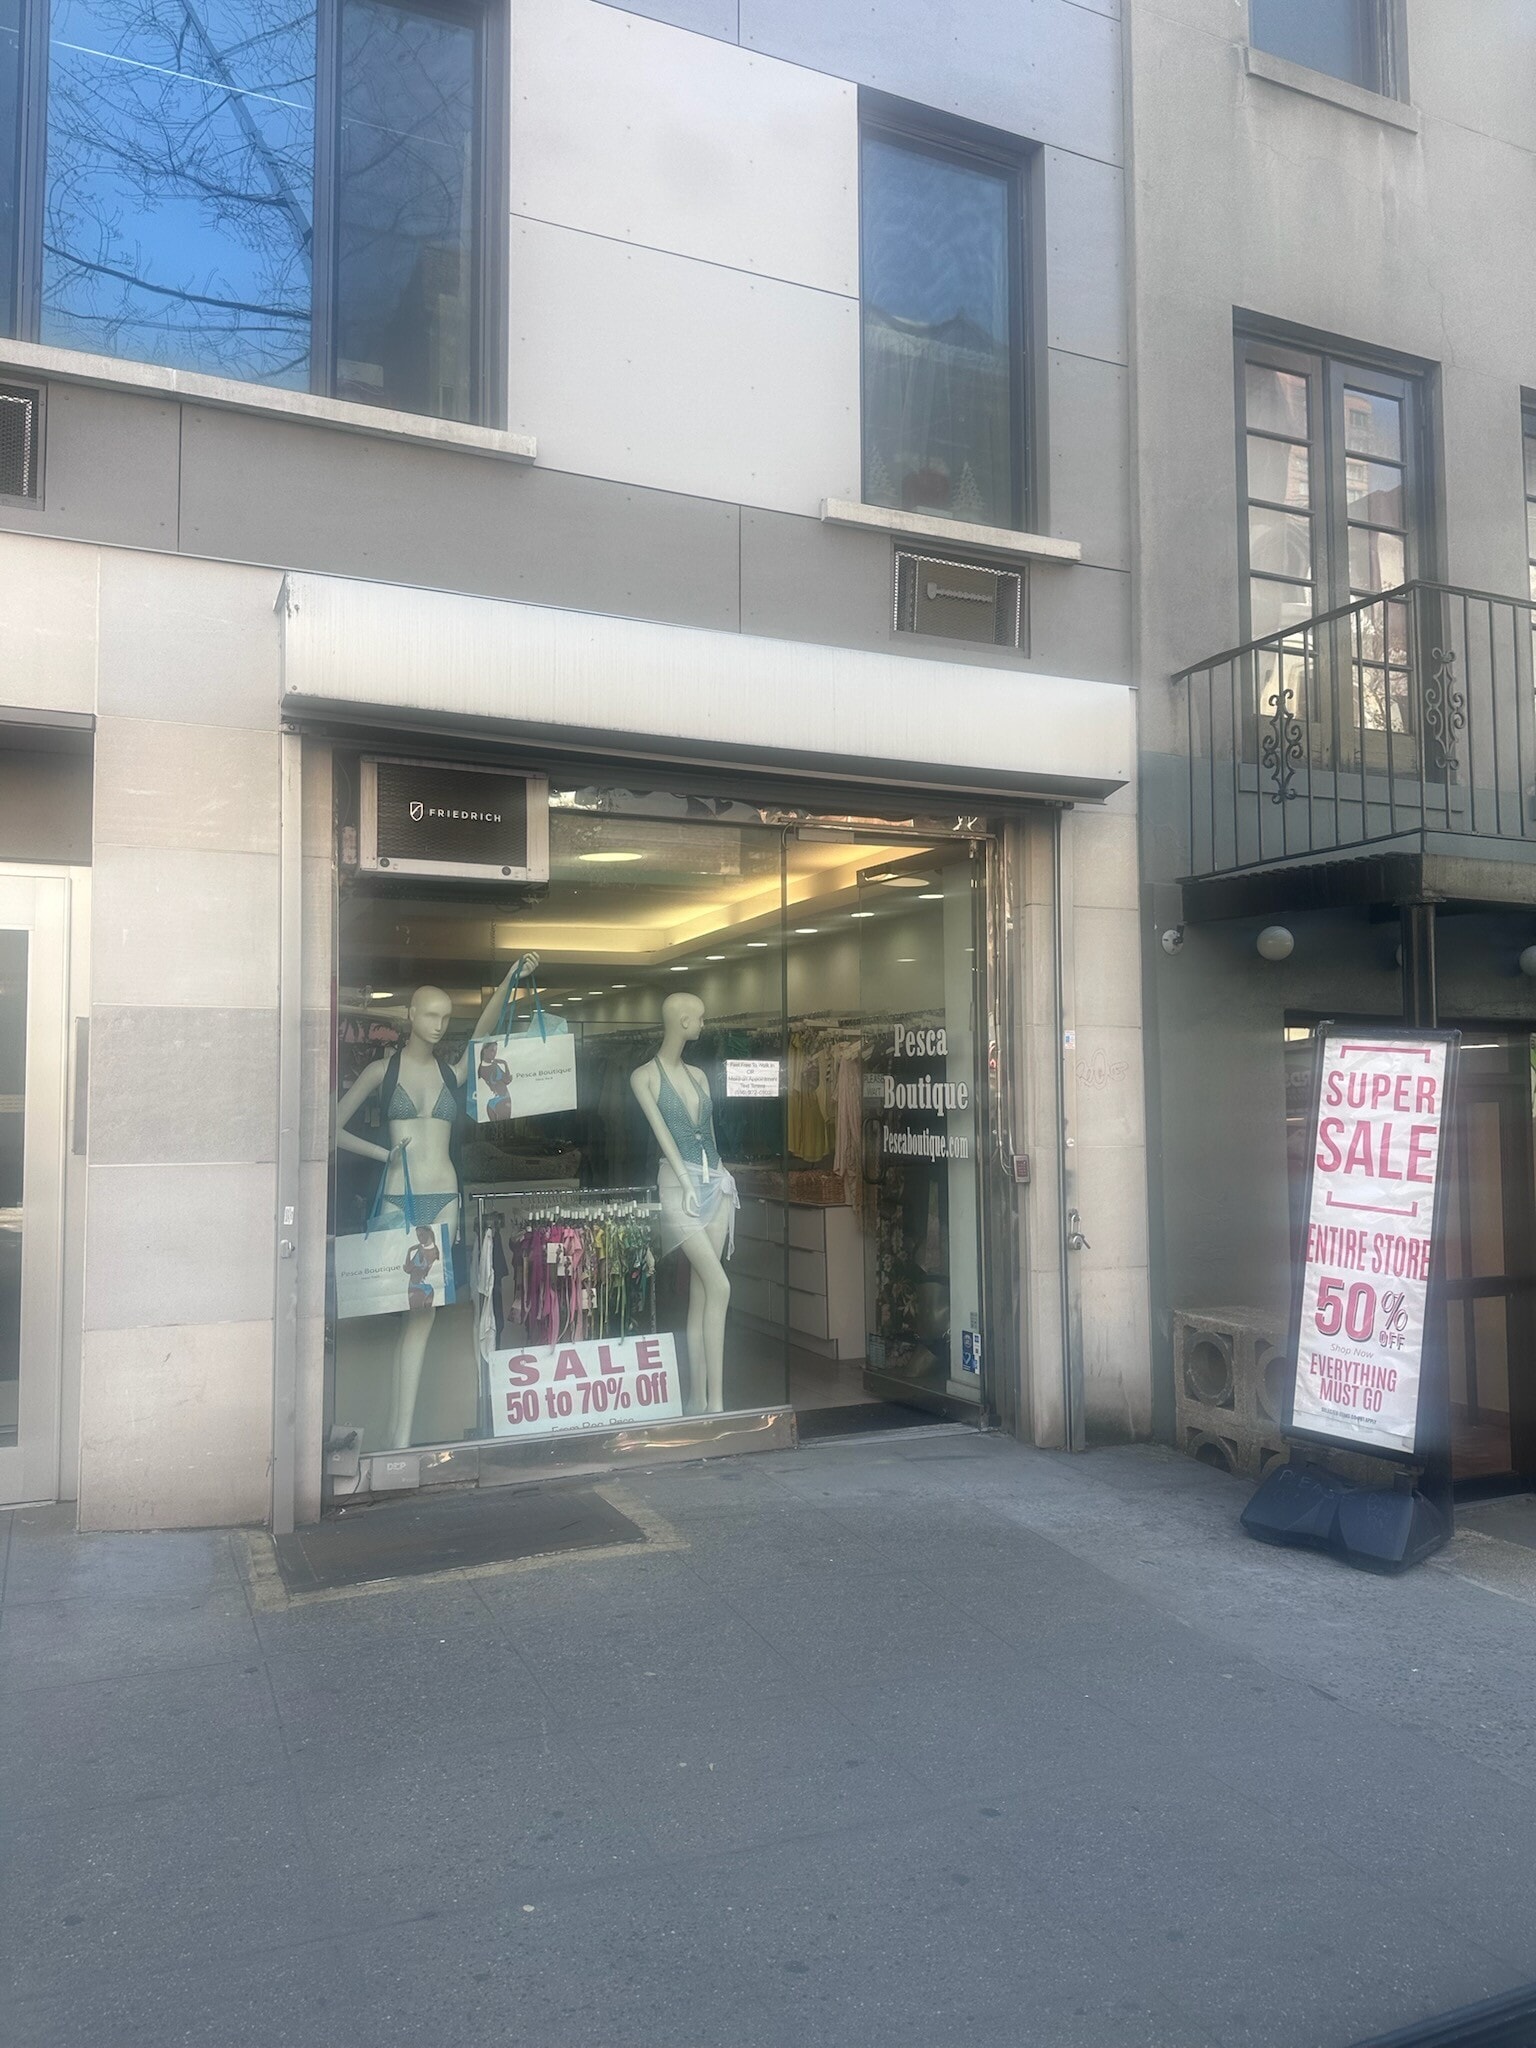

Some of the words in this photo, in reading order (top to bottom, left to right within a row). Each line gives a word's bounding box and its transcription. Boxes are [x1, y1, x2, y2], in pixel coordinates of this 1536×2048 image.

[429, 808, 501, 823] FRIEDRICH
[893, 1023, 948, 1057] Pesca
[538, 1066, 572, 1077] Boutique
[883, 1073, 969, 1117] Boutique
[1326, 1070, 1437, 1114] SUPER
[883, 1125, 969, 1162] Pescaboutique.com
[1316, 1116, 1438, 1184] SALE
[364, 1265, 401, 1275] Boutique
[1305, 1223, 1368, 1271] ENTIRE
[1371, 1232, 1431, 1281] STORE
[1330, 1343, 1351, 1356] Shop
[1353, 1348, 1374, 1359] Now
[1379, 1330, 1406, 1350] OFF
[508, 1339, 663, 1387] SALE
[1310, 1352, 1397, 1392] EVERYTHING
[506, 1389, 540, 1425] 50
[545, 1387, 573, 1419] to
[576, 1376, 631, 1414] 70%
[636, 1371, 669, 1407] Off
[1319, 1377, 1359, 1408] MUST
[1362, 1387, 1382, 1413] GO
[387, 1462, 406, 1471] DEP
